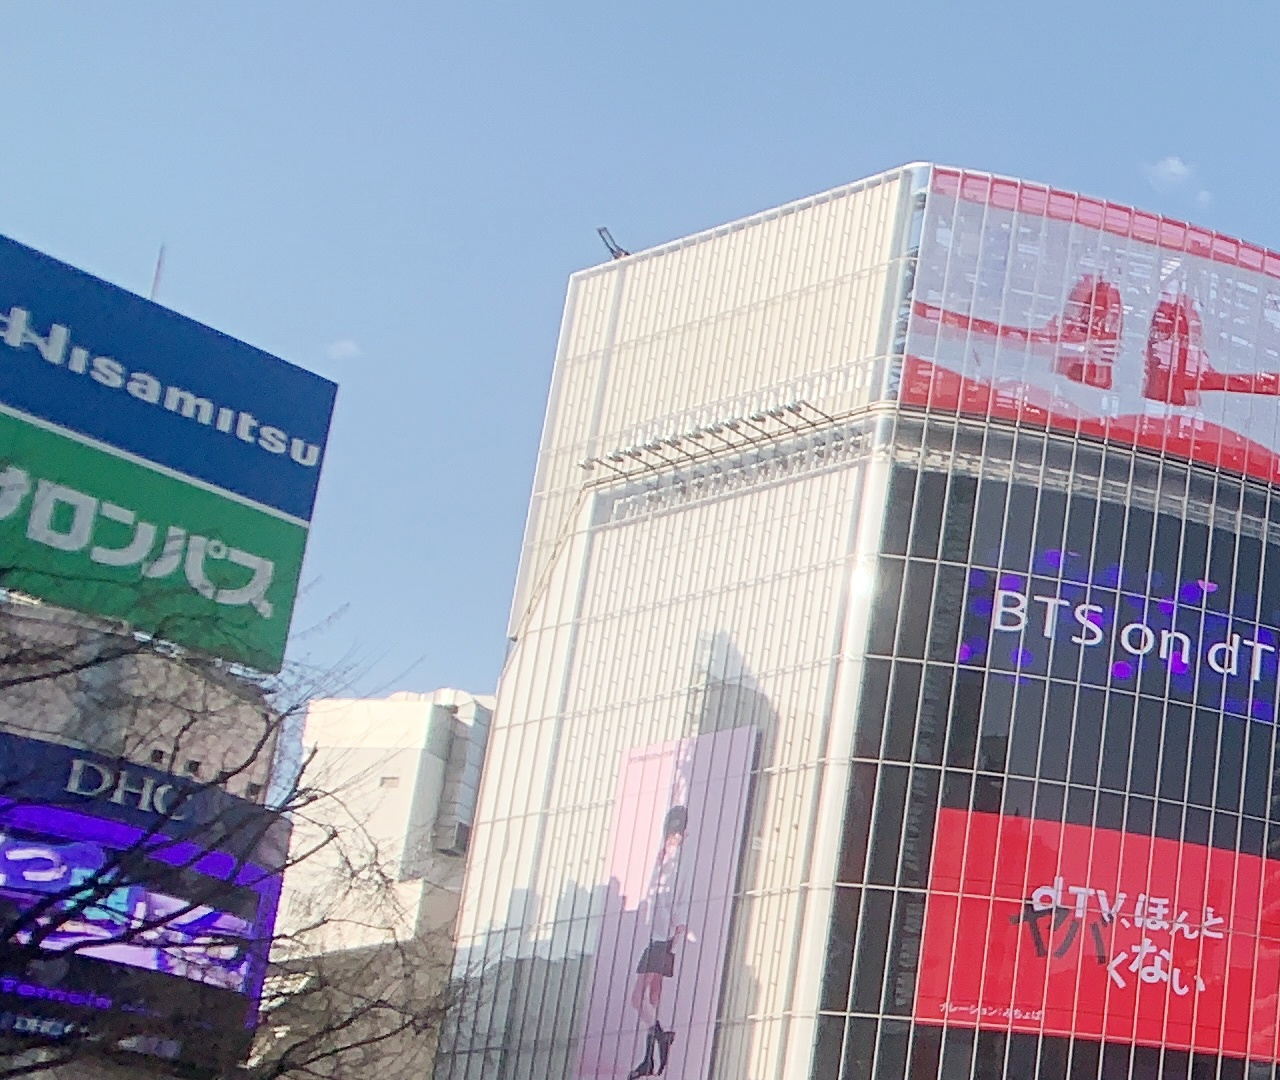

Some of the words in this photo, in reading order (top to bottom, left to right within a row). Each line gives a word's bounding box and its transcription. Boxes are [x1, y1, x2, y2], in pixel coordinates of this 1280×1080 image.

[0, 306, 323, 468] Hisamitsu
[990, 589, 1104, 647] BTS
[1120, 624, 1190, 664] on
[63, 758, 193, 822] DHC
[1031, 876, 1225, 939] dTV、ほんと
